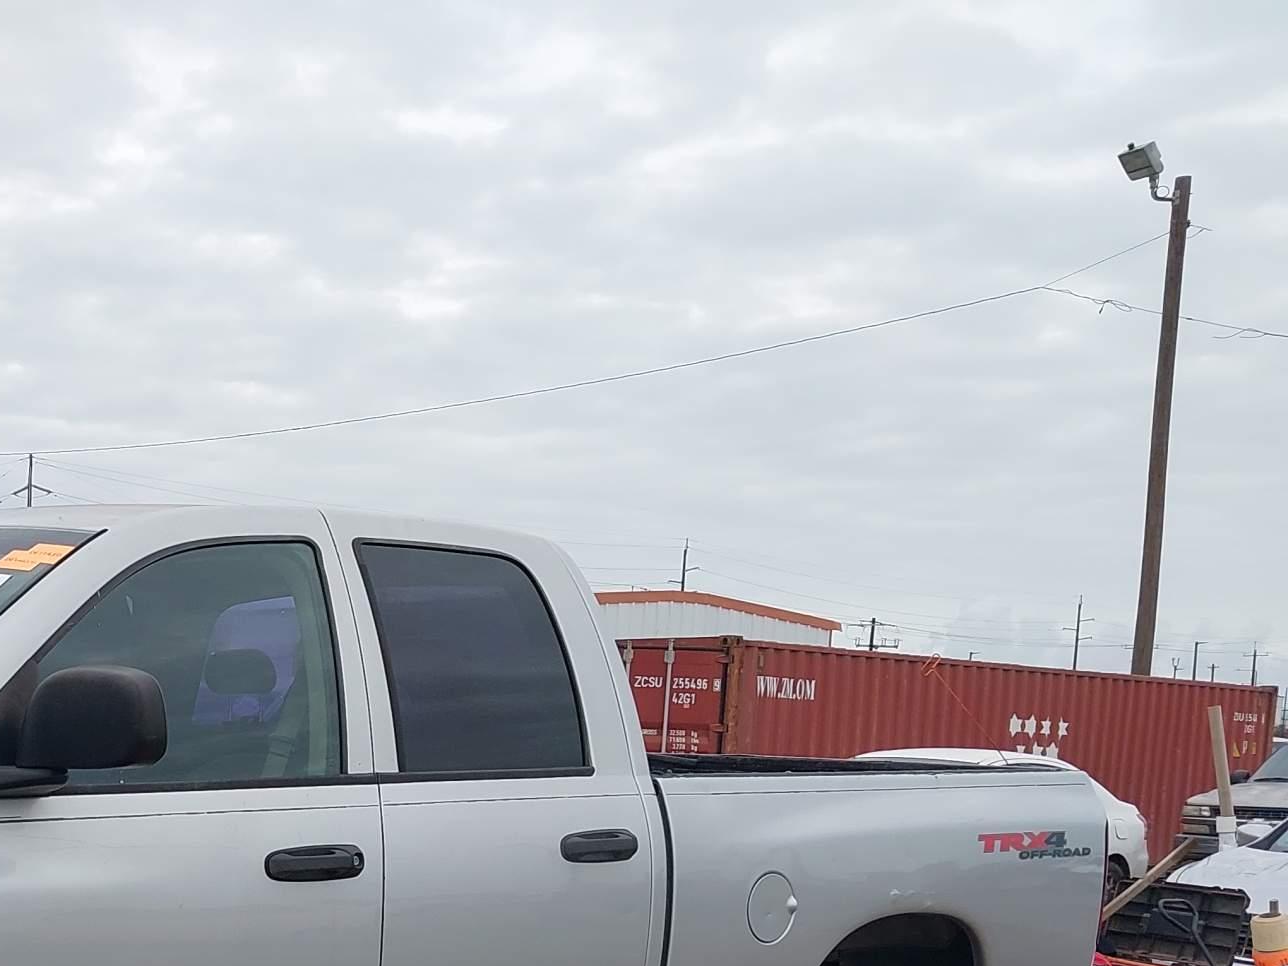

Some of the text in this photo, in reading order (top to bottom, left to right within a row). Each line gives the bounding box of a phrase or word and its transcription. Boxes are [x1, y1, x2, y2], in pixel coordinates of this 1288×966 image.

[634, 676, 663, 688] ZCSU
[672, 677, 709, 690] 255496
[672, 692, 696, 704] 42G1
[977, 831, 1067, 853] TRX4
[1018, 847, 1092, 860] OFF-ROAD
